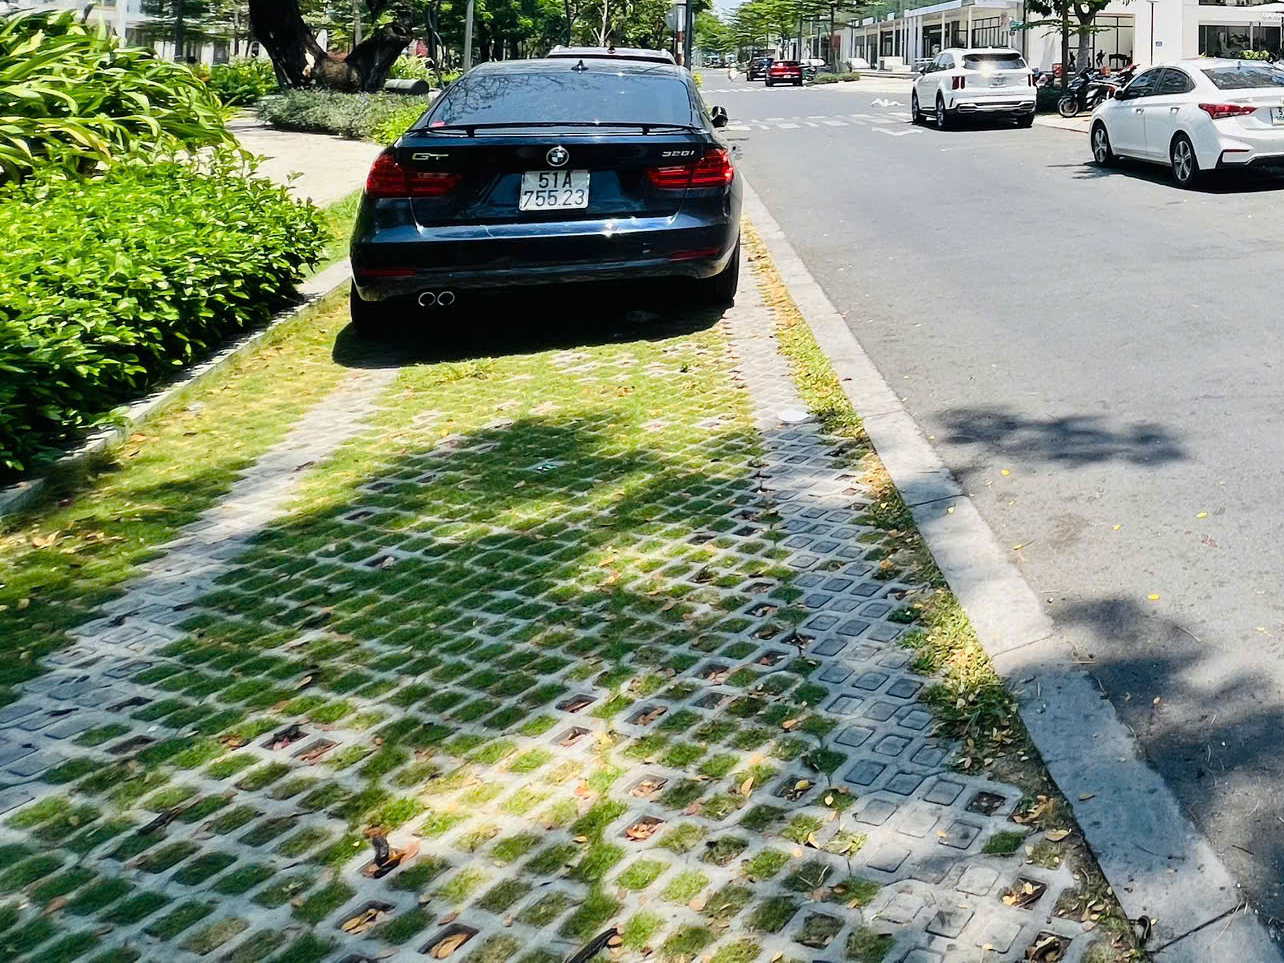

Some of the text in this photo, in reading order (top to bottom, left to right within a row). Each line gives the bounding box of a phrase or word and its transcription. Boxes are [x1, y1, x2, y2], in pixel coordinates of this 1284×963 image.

[411, 152, 449, 161] GT
[538, 171, 572, 189] 51A
[523, 188, 585, 208] 755.23
